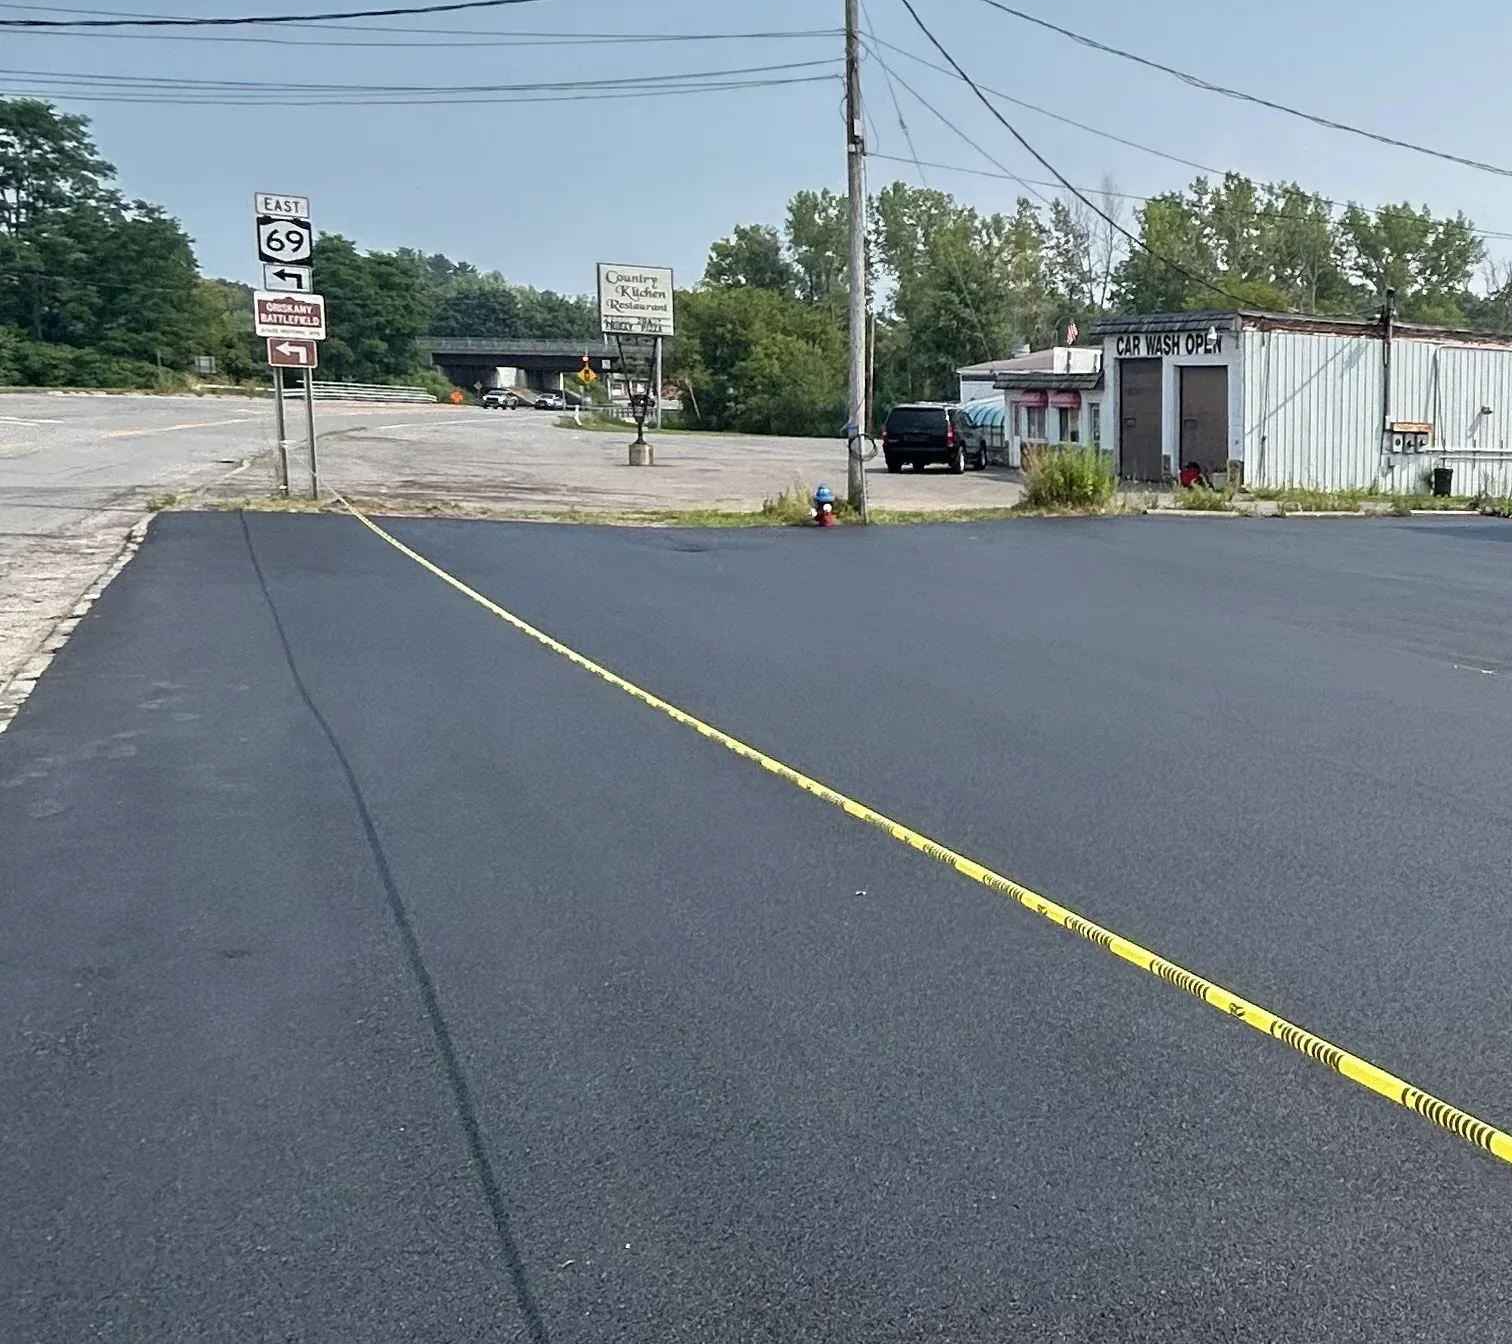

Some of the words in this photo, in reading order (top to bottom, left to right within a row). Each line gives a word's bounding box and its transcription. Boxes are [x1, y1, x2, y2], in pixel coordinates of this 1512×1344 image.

[264, 197, 301, 214] EAST
[266, 229, 304, 253] 69
[605, 270, 658, 289] Country
[615, 284, 666, 302] Kitchen
[266, 302, 313, 315] ORISKANY
[606, 298, 668, 313] Restaurant
[260, 313, 320, 326] BATTLEFIELD
[1116, 335, 1141, 355] CAR
[1145, 334, 1180, 356] WASH
